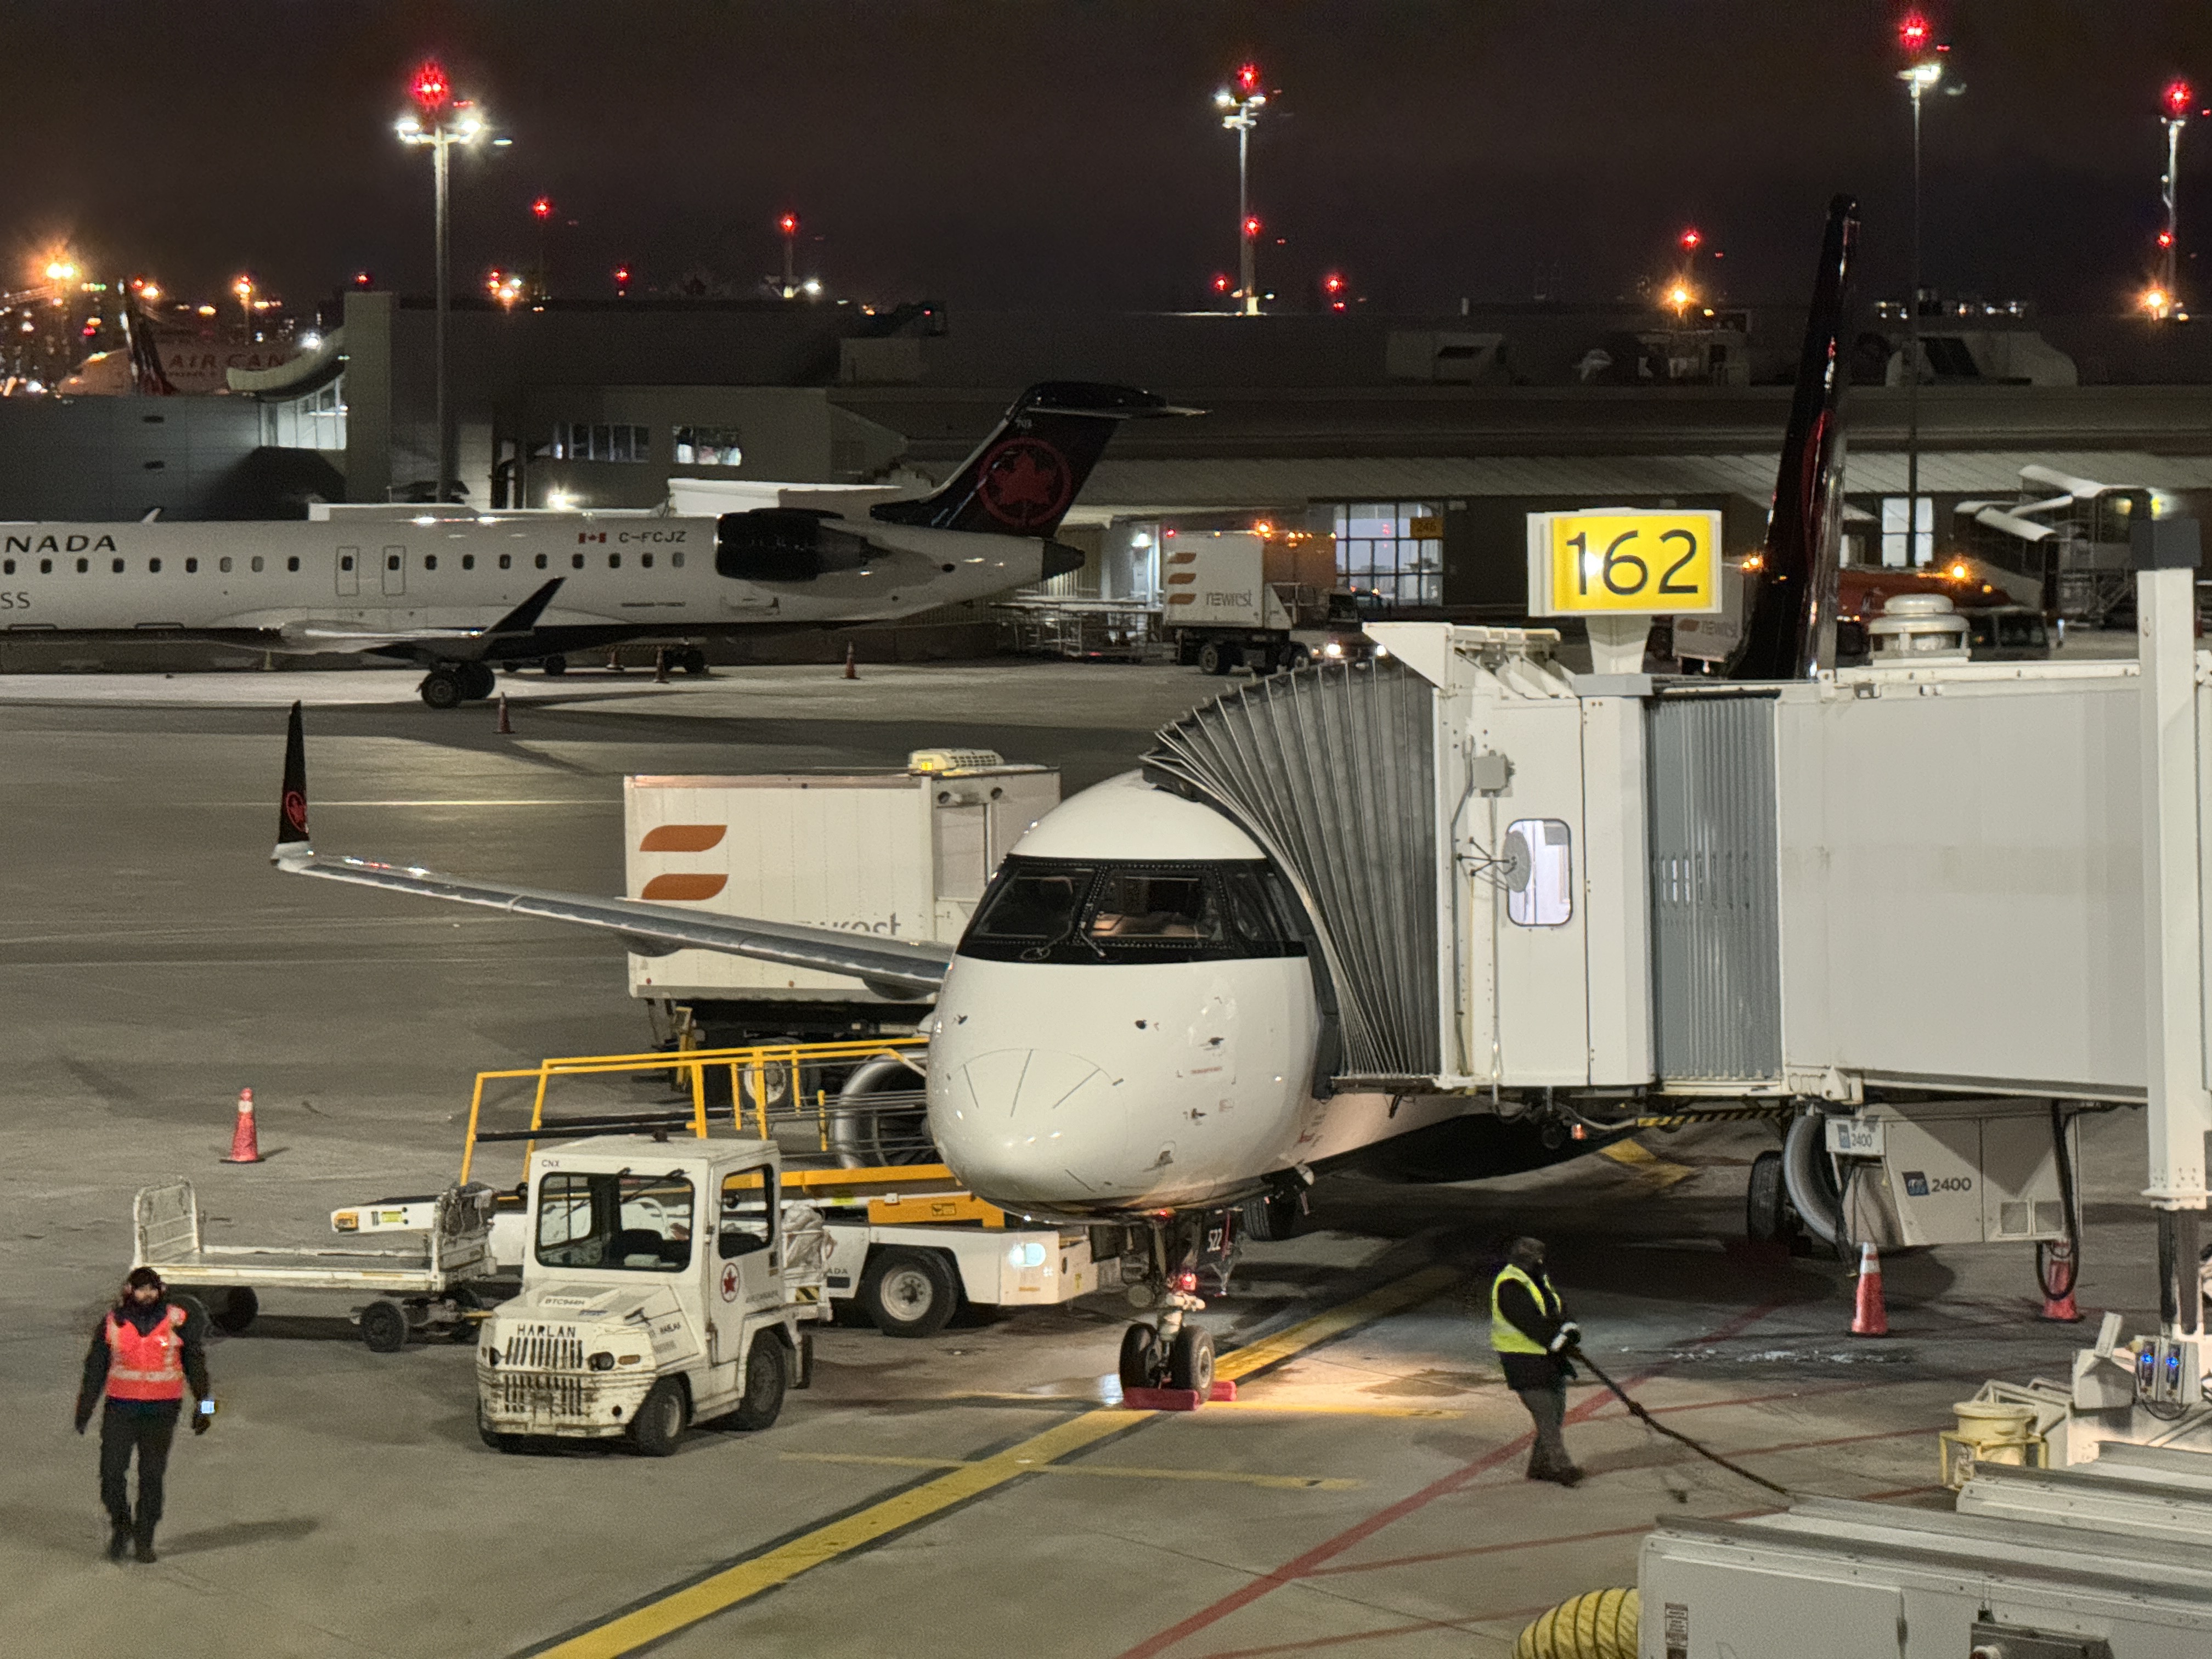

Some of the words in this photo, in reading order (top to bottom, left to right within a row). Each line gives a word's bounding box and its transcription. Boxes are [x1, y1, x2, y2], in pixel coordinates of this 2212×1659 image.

[5, 535, 116, 552] NADA
[619, 531, 686, 543] C-FCJZ
[1566, 529, 1698, 595] 162
[1852, 1133, 1872, 1147] 2400
[1932, 1177, 1972, 1192] 2400
[517, 1324, 576, 1338] HARLAN
